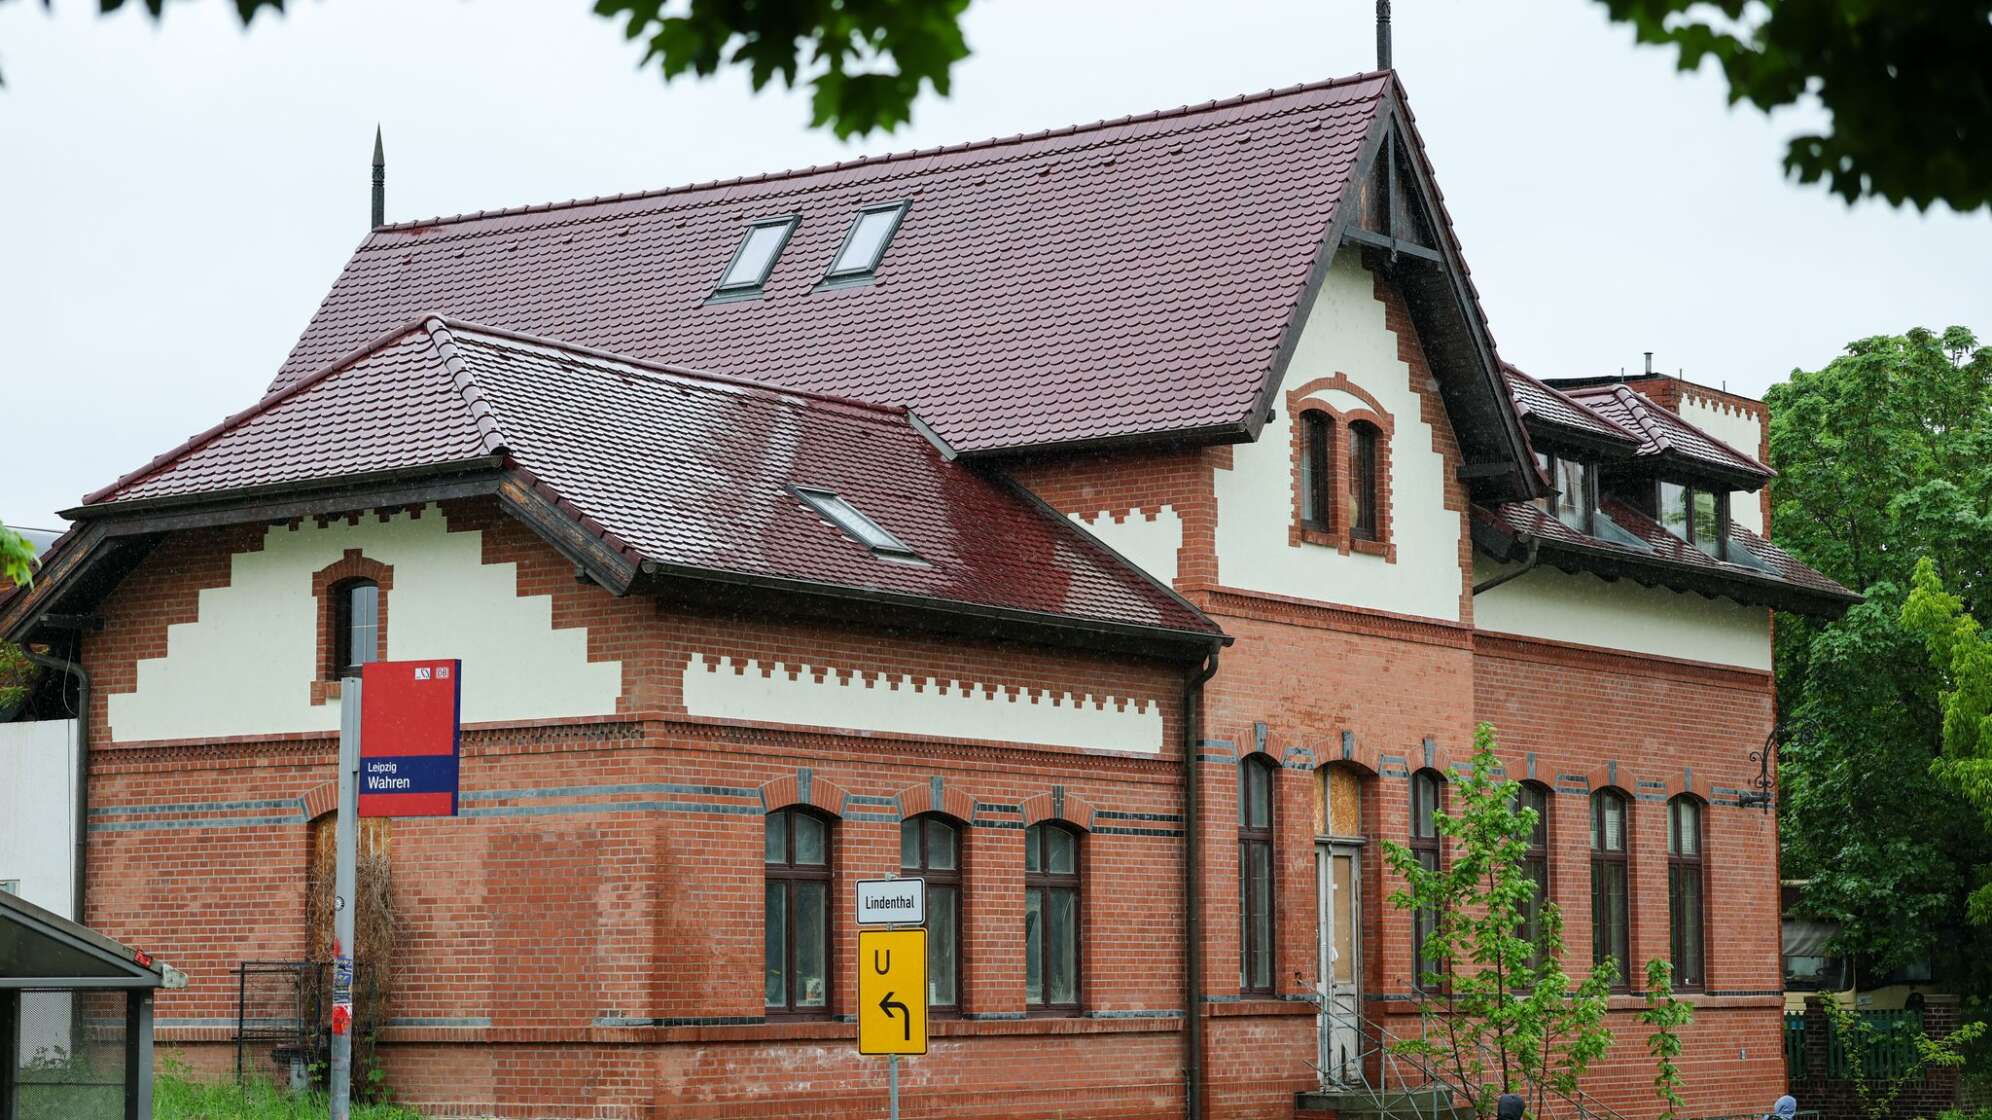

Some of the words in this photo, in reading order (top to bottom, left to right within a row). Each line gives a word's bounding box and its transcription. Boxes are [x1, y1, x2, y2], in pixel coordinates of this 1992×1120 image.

[368, 762, 397, 774] Leipzig
[368, 776, 410, 789] Wahren
[865, 894, 915, 909] Lindenthal
[874, 949, 890, 975] U
